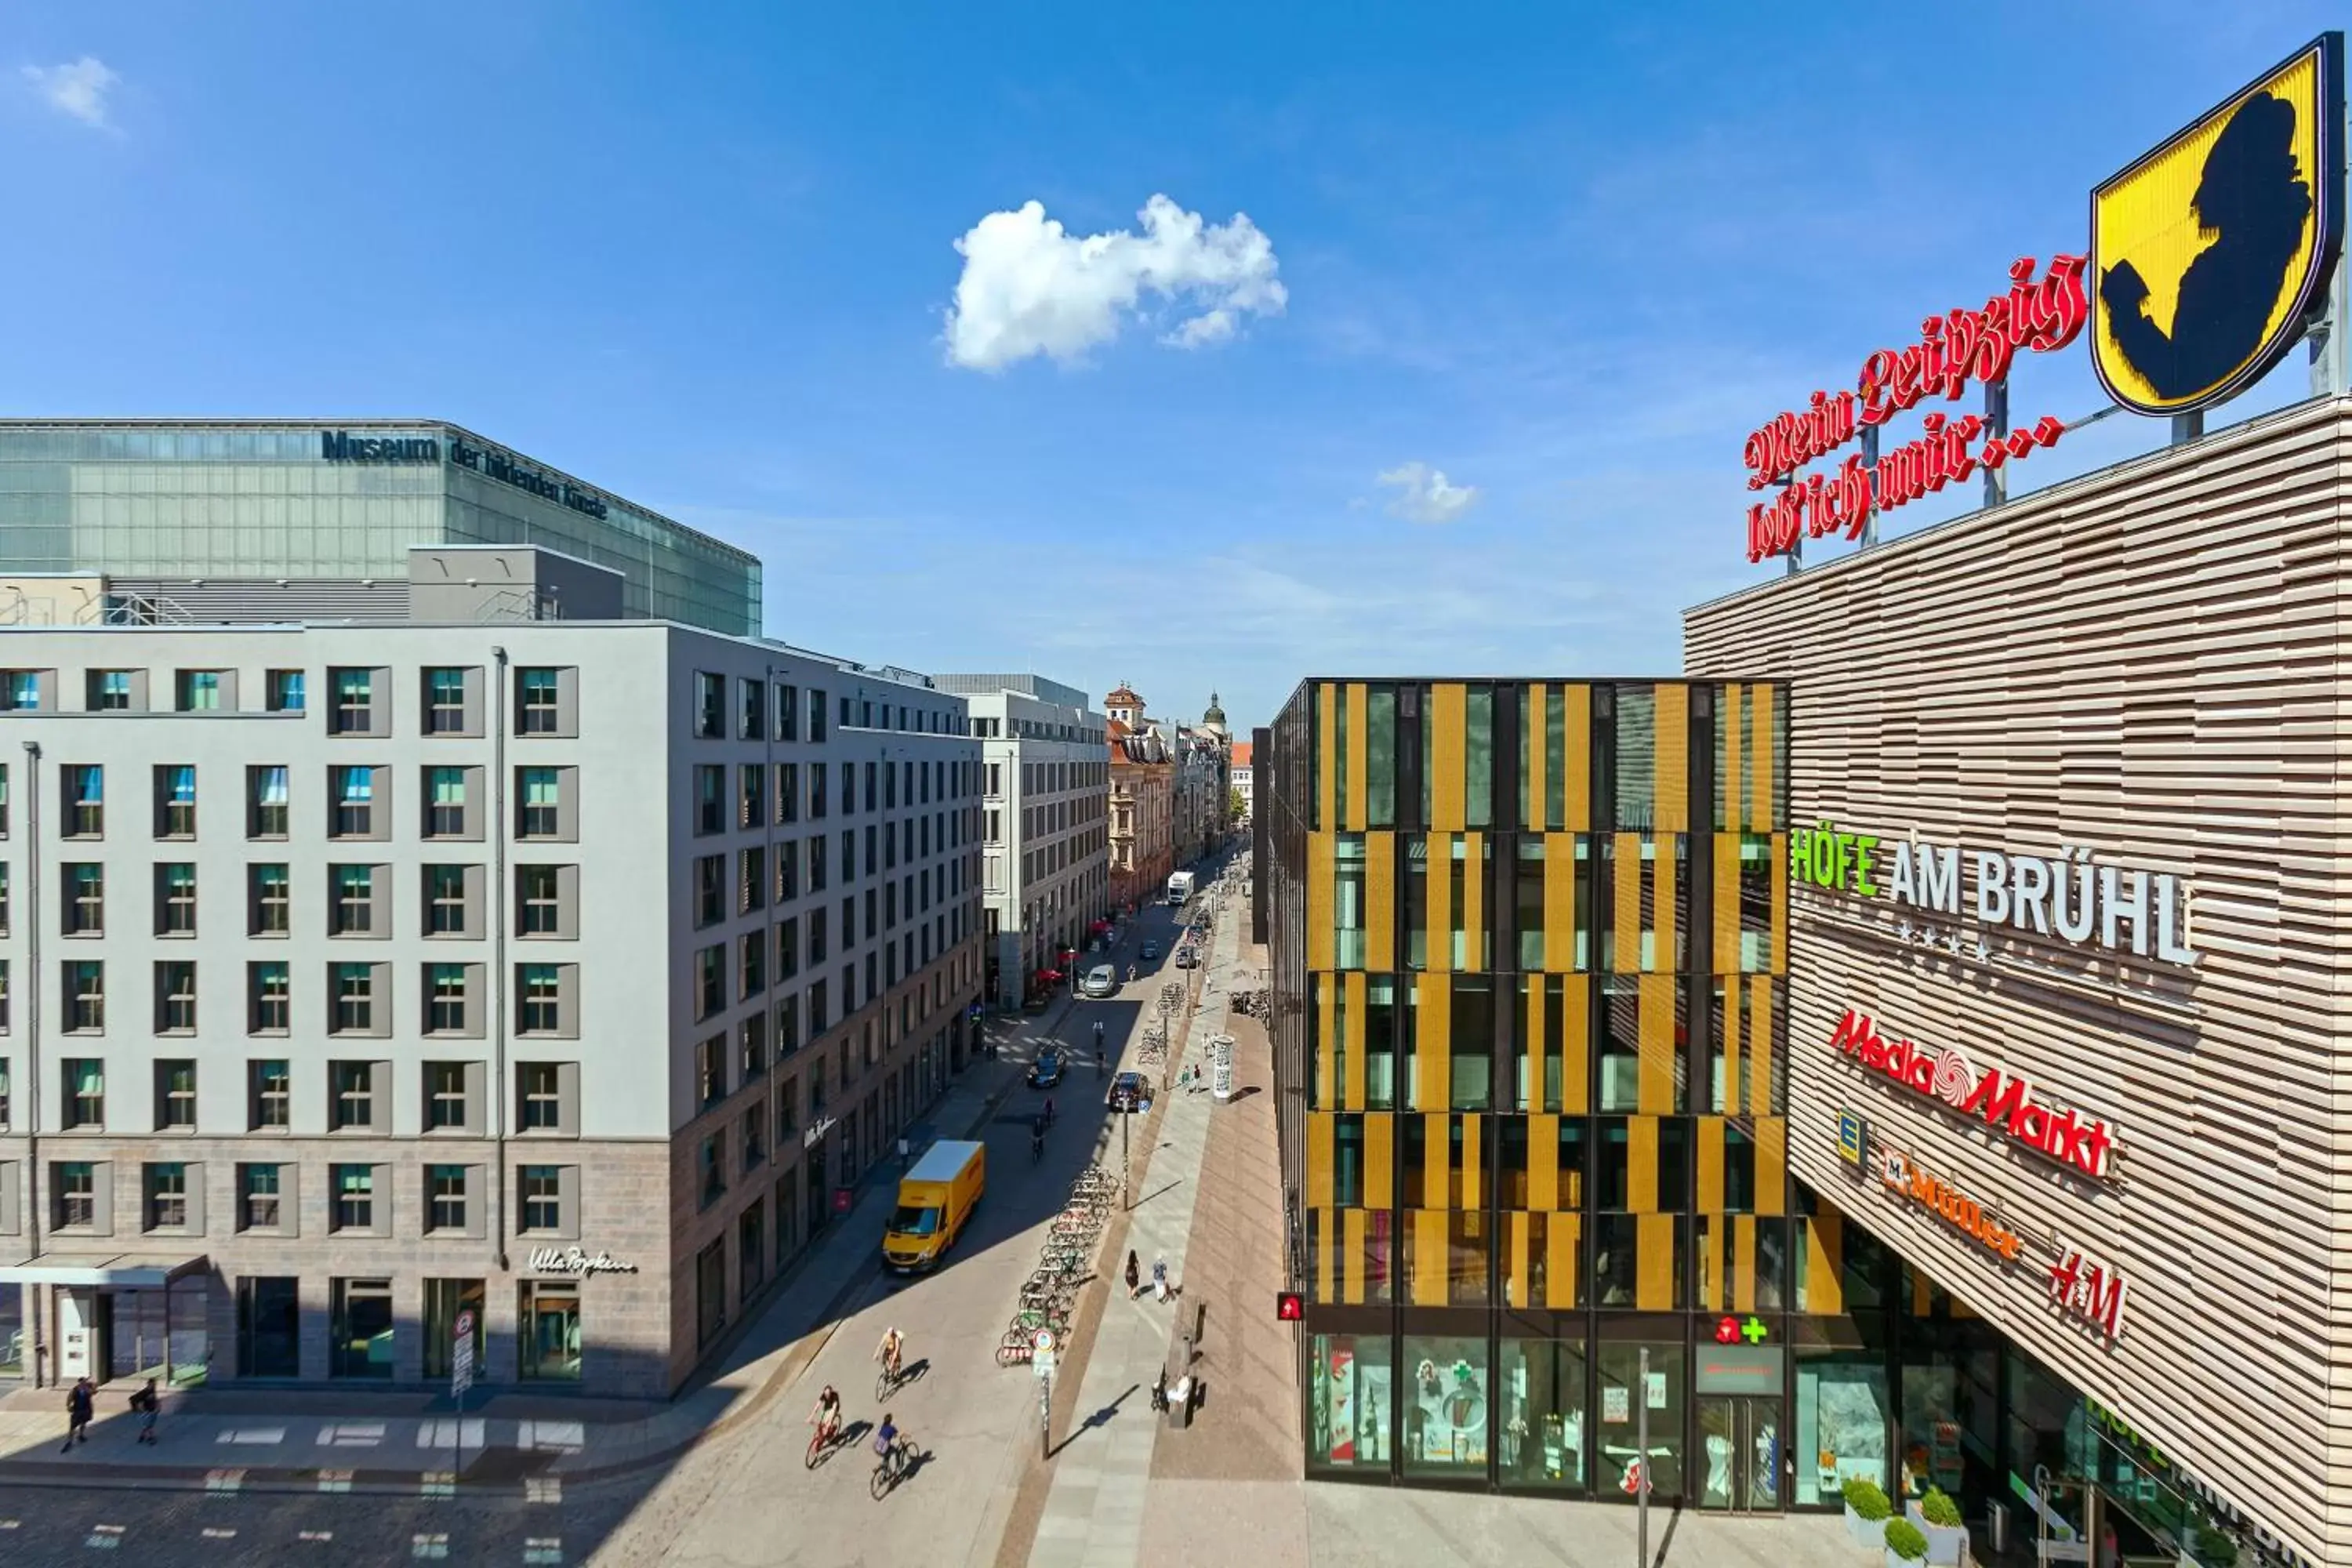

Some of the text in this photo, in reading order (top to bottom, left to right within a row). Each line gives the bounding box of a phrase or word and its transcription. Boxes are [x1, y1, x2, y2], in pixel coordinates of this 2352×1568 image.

[1744, 254, 2088, 490] Mein Leipzig
[322, 430, 438, 461] Museum
[451, 437, 478, 471] der
[485, 450, 559, 503] bildenden
[1791, 820, 2205, 967] HÖFE AM BRÜHL
[1831, 1008, 2114, 1176] Media Markt
[528, 1245, 564, 1270] Ulla
[1911, 1166, 2020, 1261] Müller
